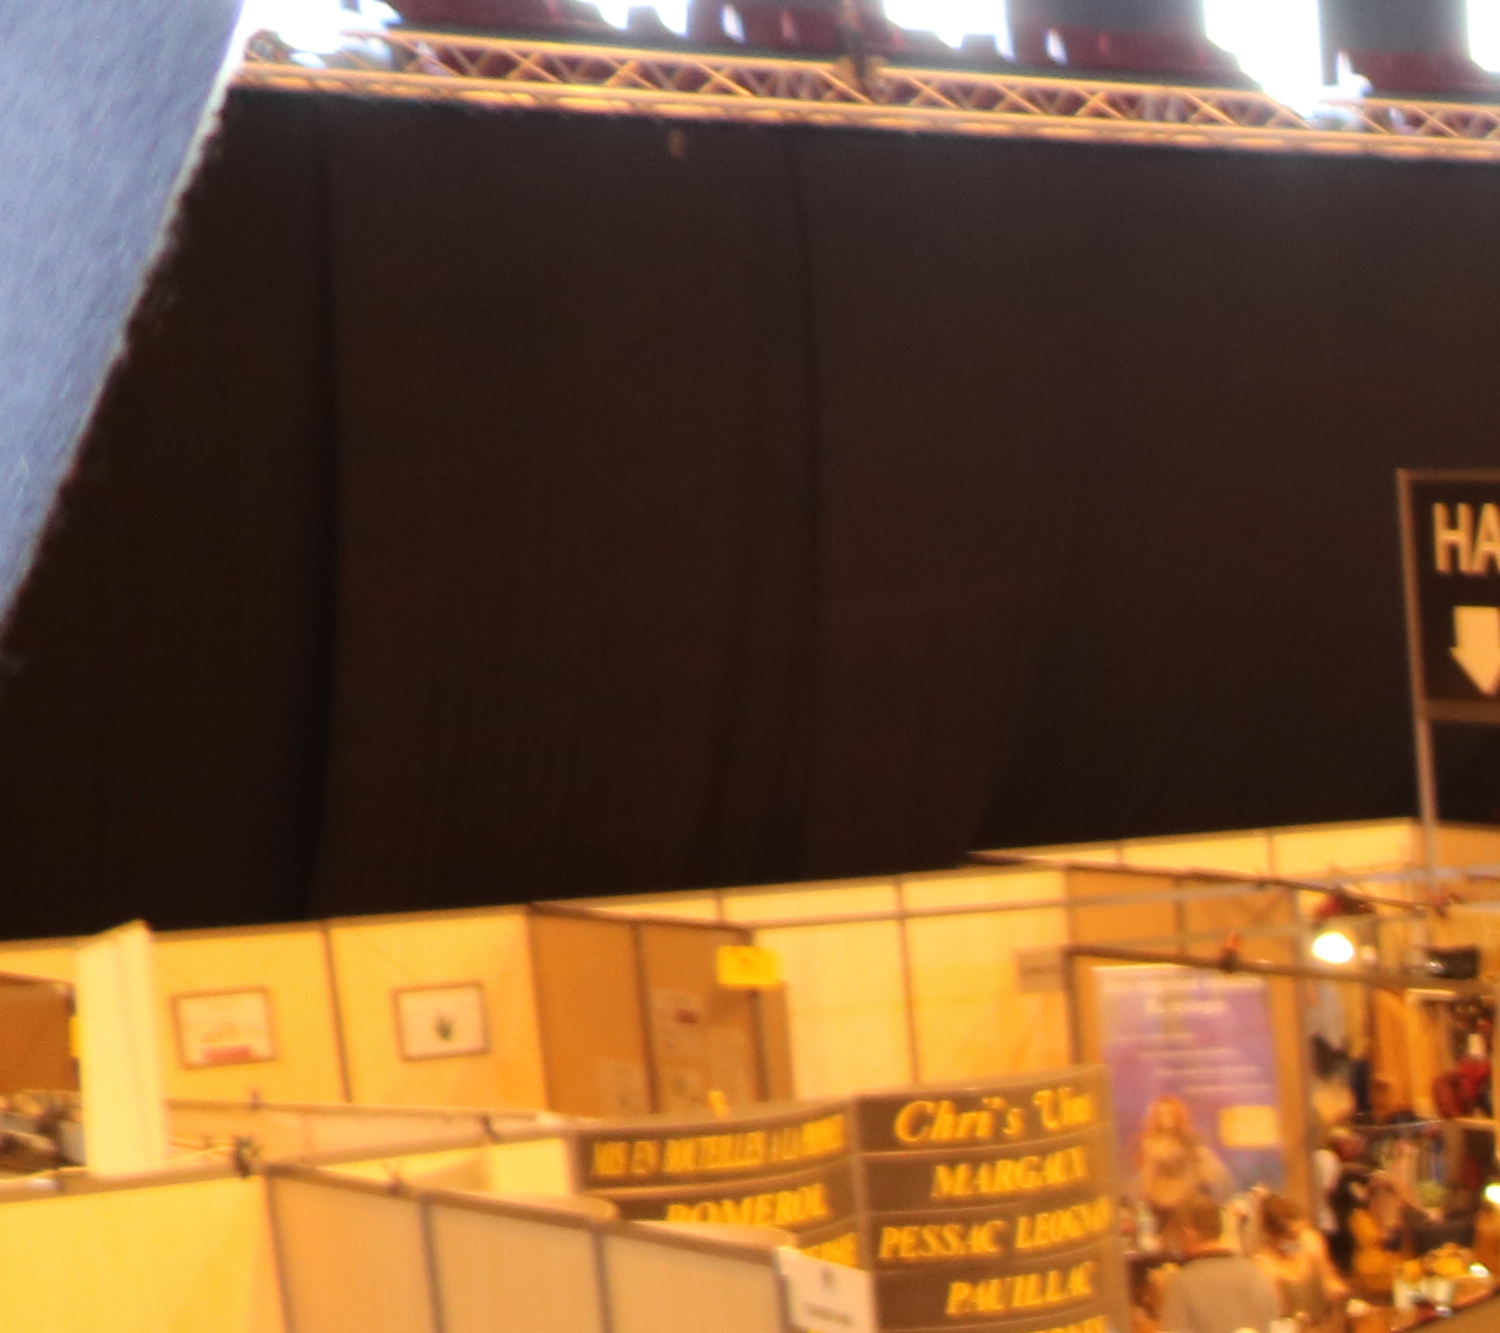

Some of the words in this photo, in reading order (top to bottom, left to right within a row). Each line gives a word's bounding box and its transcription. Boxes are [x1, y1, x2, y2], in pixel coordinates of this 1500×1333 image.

[930, 1145, 1090, 1199] MARGAUX
[877, 1220, 1007, 1262] PESSAC
[944, 1261, 1095, 1318] PAUILLAC
